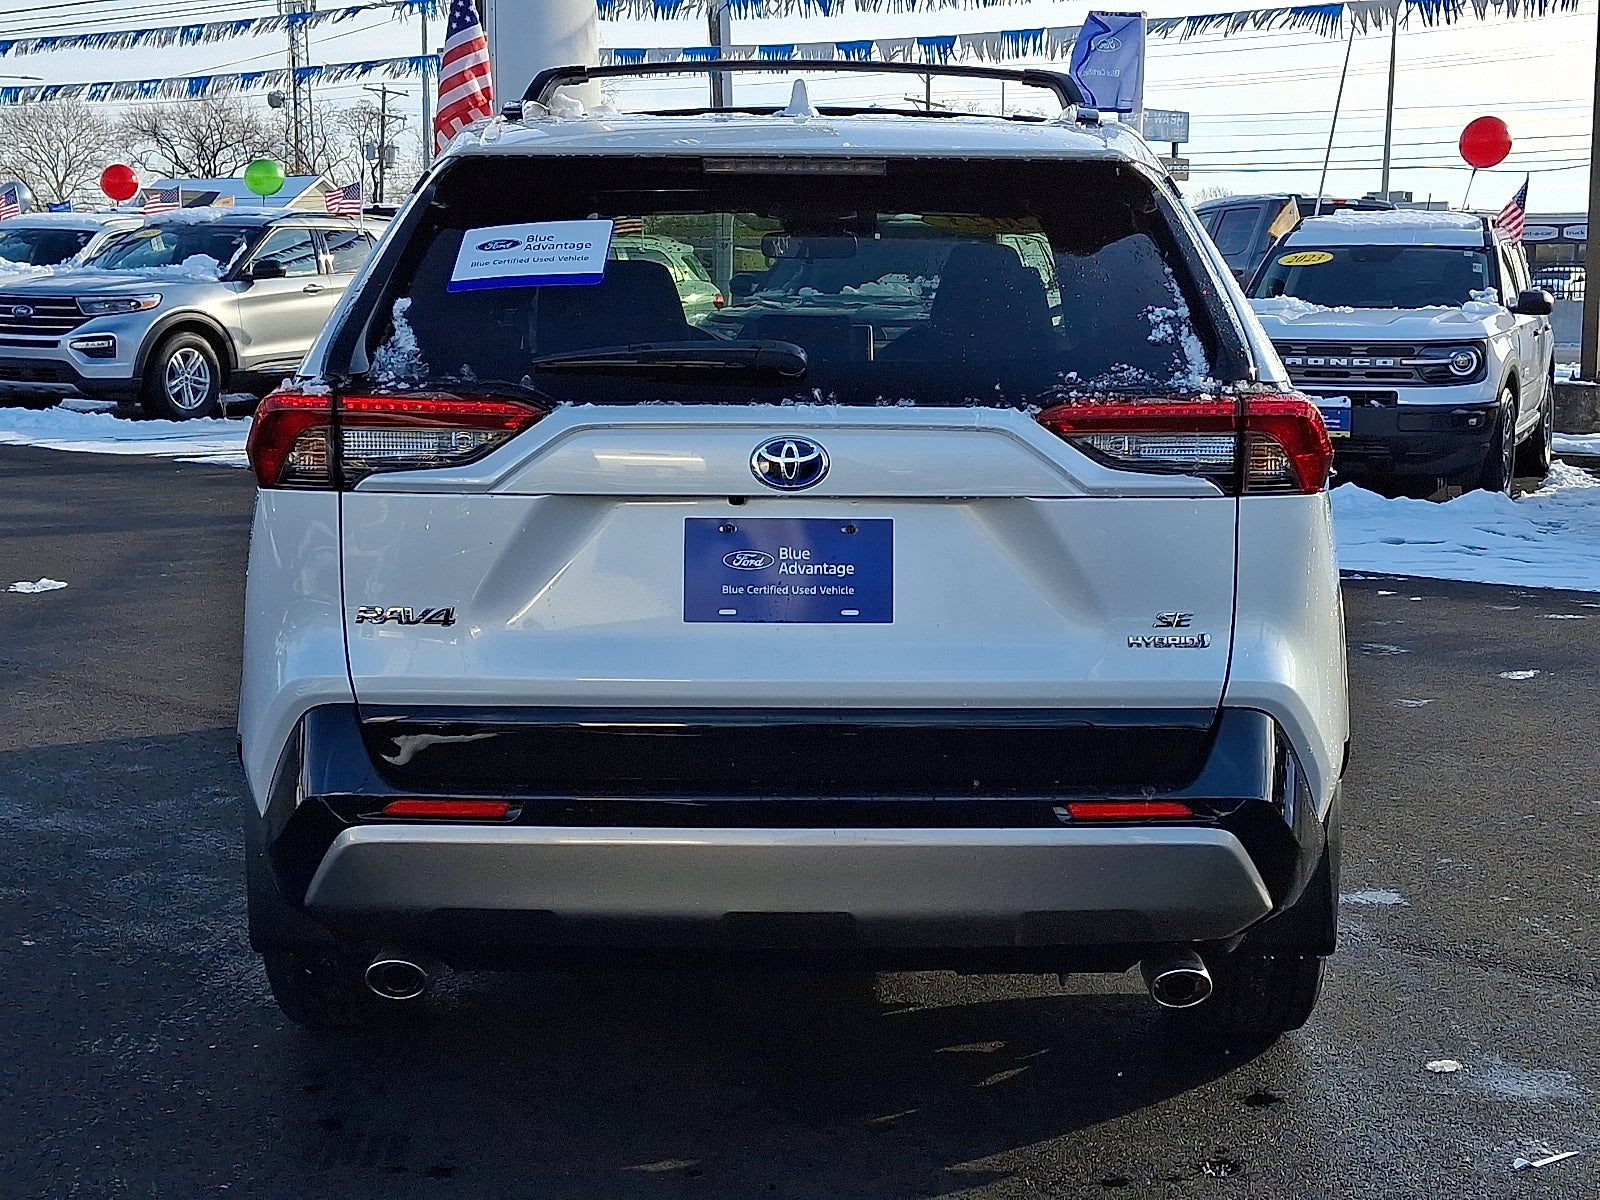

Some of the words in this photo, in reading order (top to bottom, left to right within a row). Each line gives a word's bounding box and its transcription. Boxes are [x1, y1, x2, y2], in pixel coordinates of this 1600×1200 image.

[1154, 112, 1184, 126] WASH
[526, 234, 555, 243] Blue
[523, 241, 592, 252] Advantage
[470, 260, 490, 268] Blue
[492, 256, 530, 266] Certified
[532, 255, 555, 263] Used
[557, 254, 590, 262] Vehicle
[1285, 357, 1394, 366] RONCO
[778, 546, 811, 560] Blue
[732, 553, 765, 568] Ford
[778, 562, 855, 578] Advantage
[721, 585, 744, 595] Blue
[747, 584, 789, 595] Certified
[791, 585, 817, 595] Used
[819, 585, 855, 595] Vehicle
[355, 605, 457, 627] RAV4
[1152, 611, 1194, 628] SE
